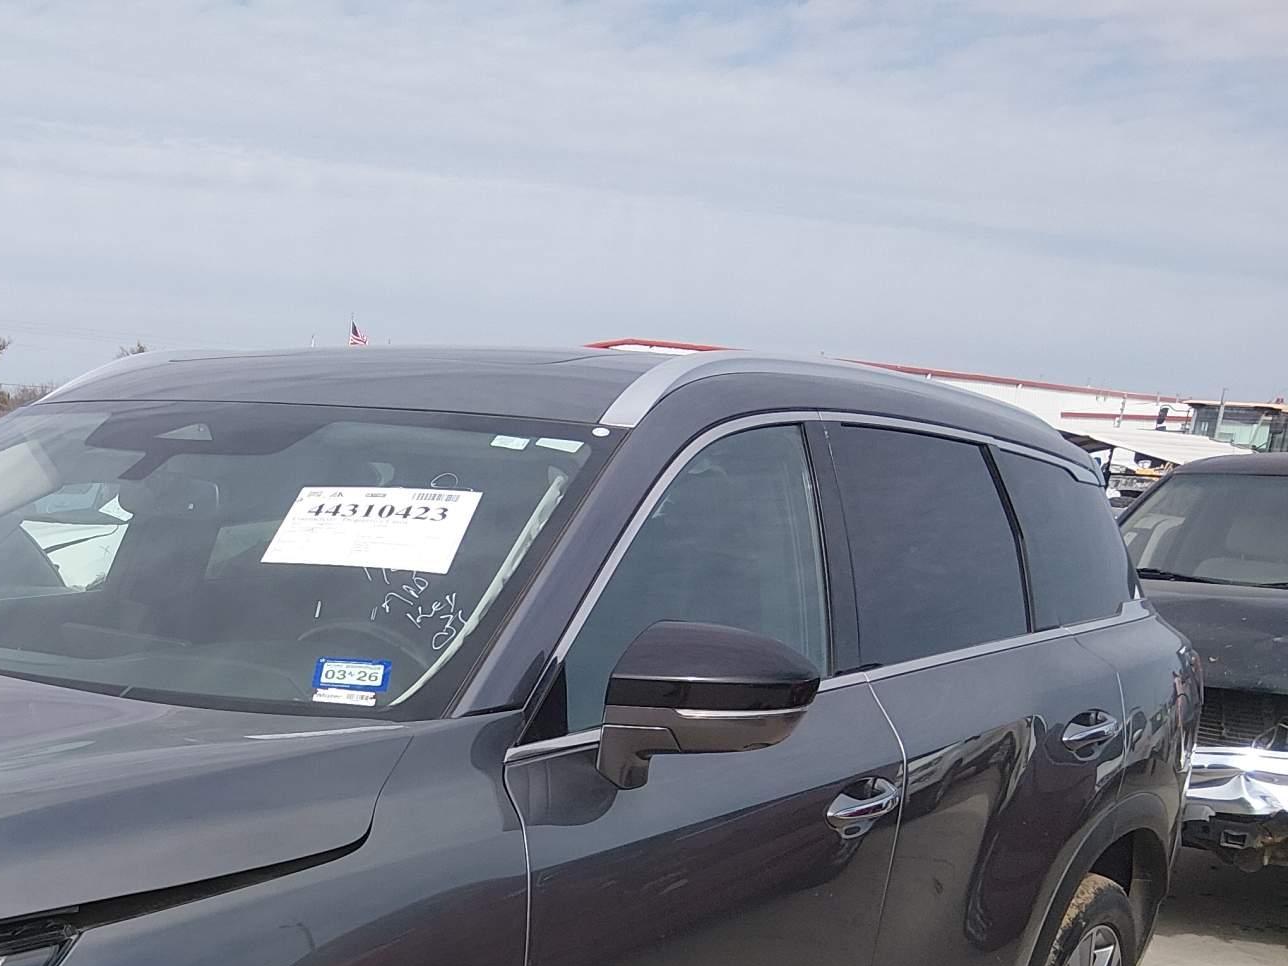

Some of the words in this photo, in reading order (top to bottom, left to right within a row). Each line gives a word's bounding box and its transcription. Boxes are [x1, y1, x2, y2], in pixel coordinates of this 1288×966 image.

[307, 502, 449, 522] 44310423
[324, 669, 347, 681] 03
[356, 670, 379, 682] 26
